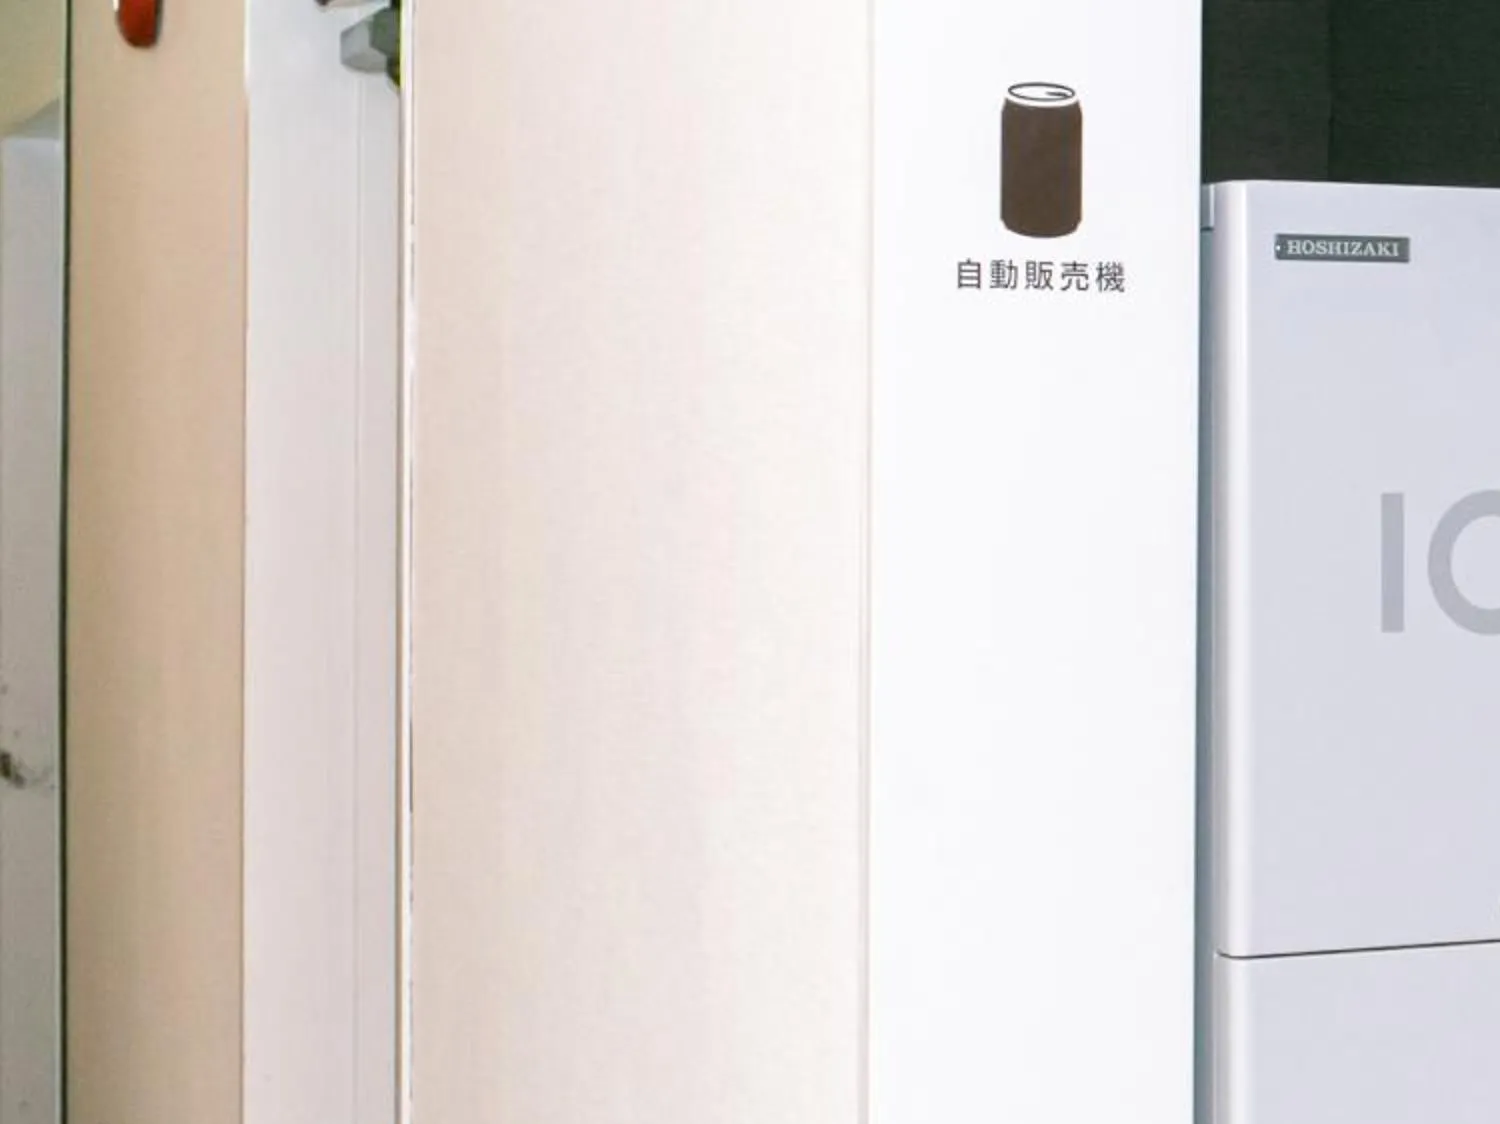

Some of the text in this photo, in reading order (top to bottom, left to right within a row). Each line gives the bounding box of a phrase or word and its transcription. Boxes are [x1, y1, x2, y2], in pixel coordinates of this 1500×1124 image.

[1286, 239, 1399, 257] HOSHIZAKI
[956, 258, 1126, 293] 自動販売機
